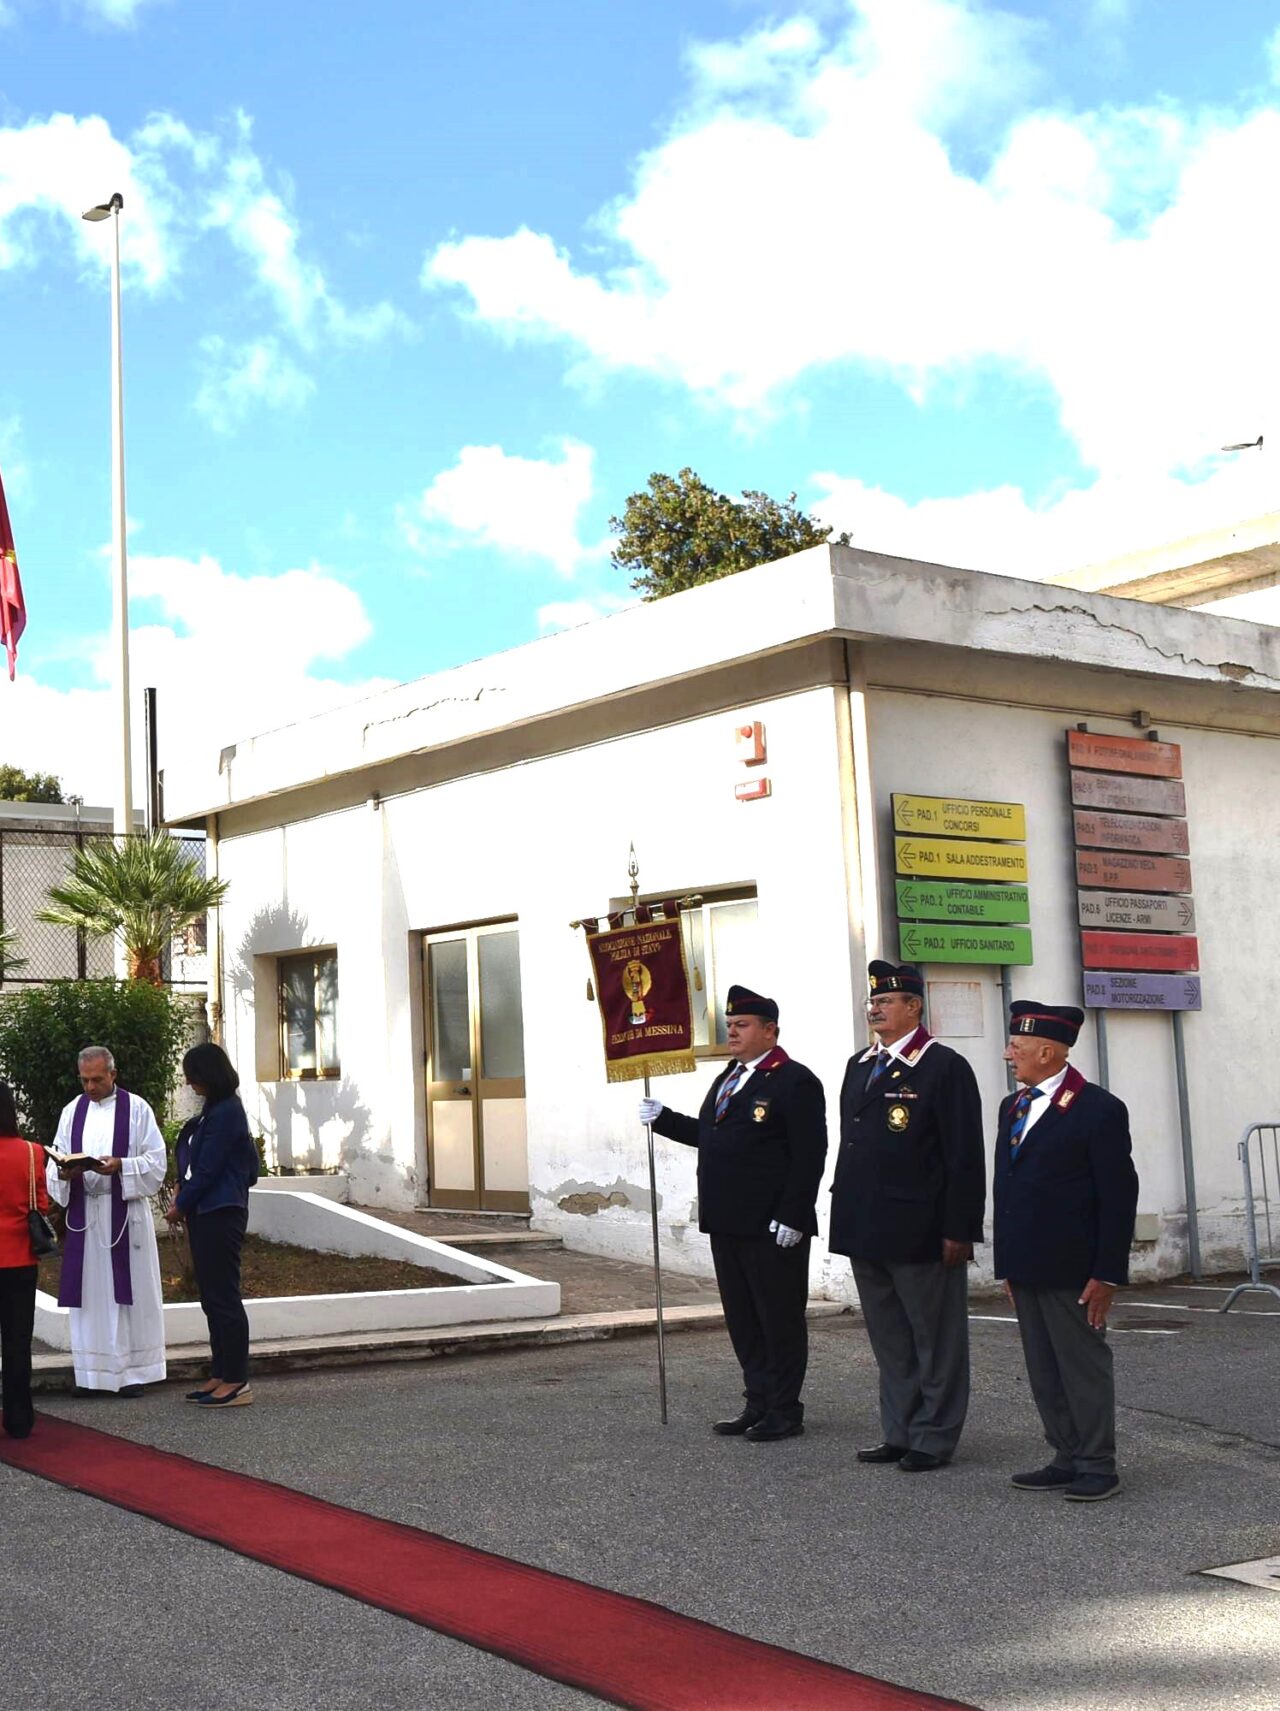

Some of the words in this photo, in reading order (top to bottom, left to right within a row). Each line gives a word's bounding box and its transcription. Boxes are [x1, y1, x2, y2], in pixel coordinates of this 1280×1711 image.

[942, 803, 969, 816] UFFICIO
[971, 805, 1012, 819] PERSONALE
[943, 820, 980, 832] CONCORSI
[946, 853, 966, 864] SALA
[966, 854, 1025, 869] ADDESTRAMENTO
[946, 888, 973, 900] UFFICIO
[973, 889, 1028, 903] AMMINISTRATIVO
[947, 903, 985, 916] CONTABILE
[1105, 896, 1129, 908] UFFICIO
[1130, 898, 1167, 911] PASSAPORTI
[1106, 912, 1132, 924] LICENZE
[950, 938, 977, 950] UFFICIO
[979, 939, 1015, 952] SANITARIO
[1110, 977, 1137, 989] SEZIONE
[1111, 992, 1165, 1005] MOTORIZZAZIONE
[645, 1024, 684, 1037] MESSINA
